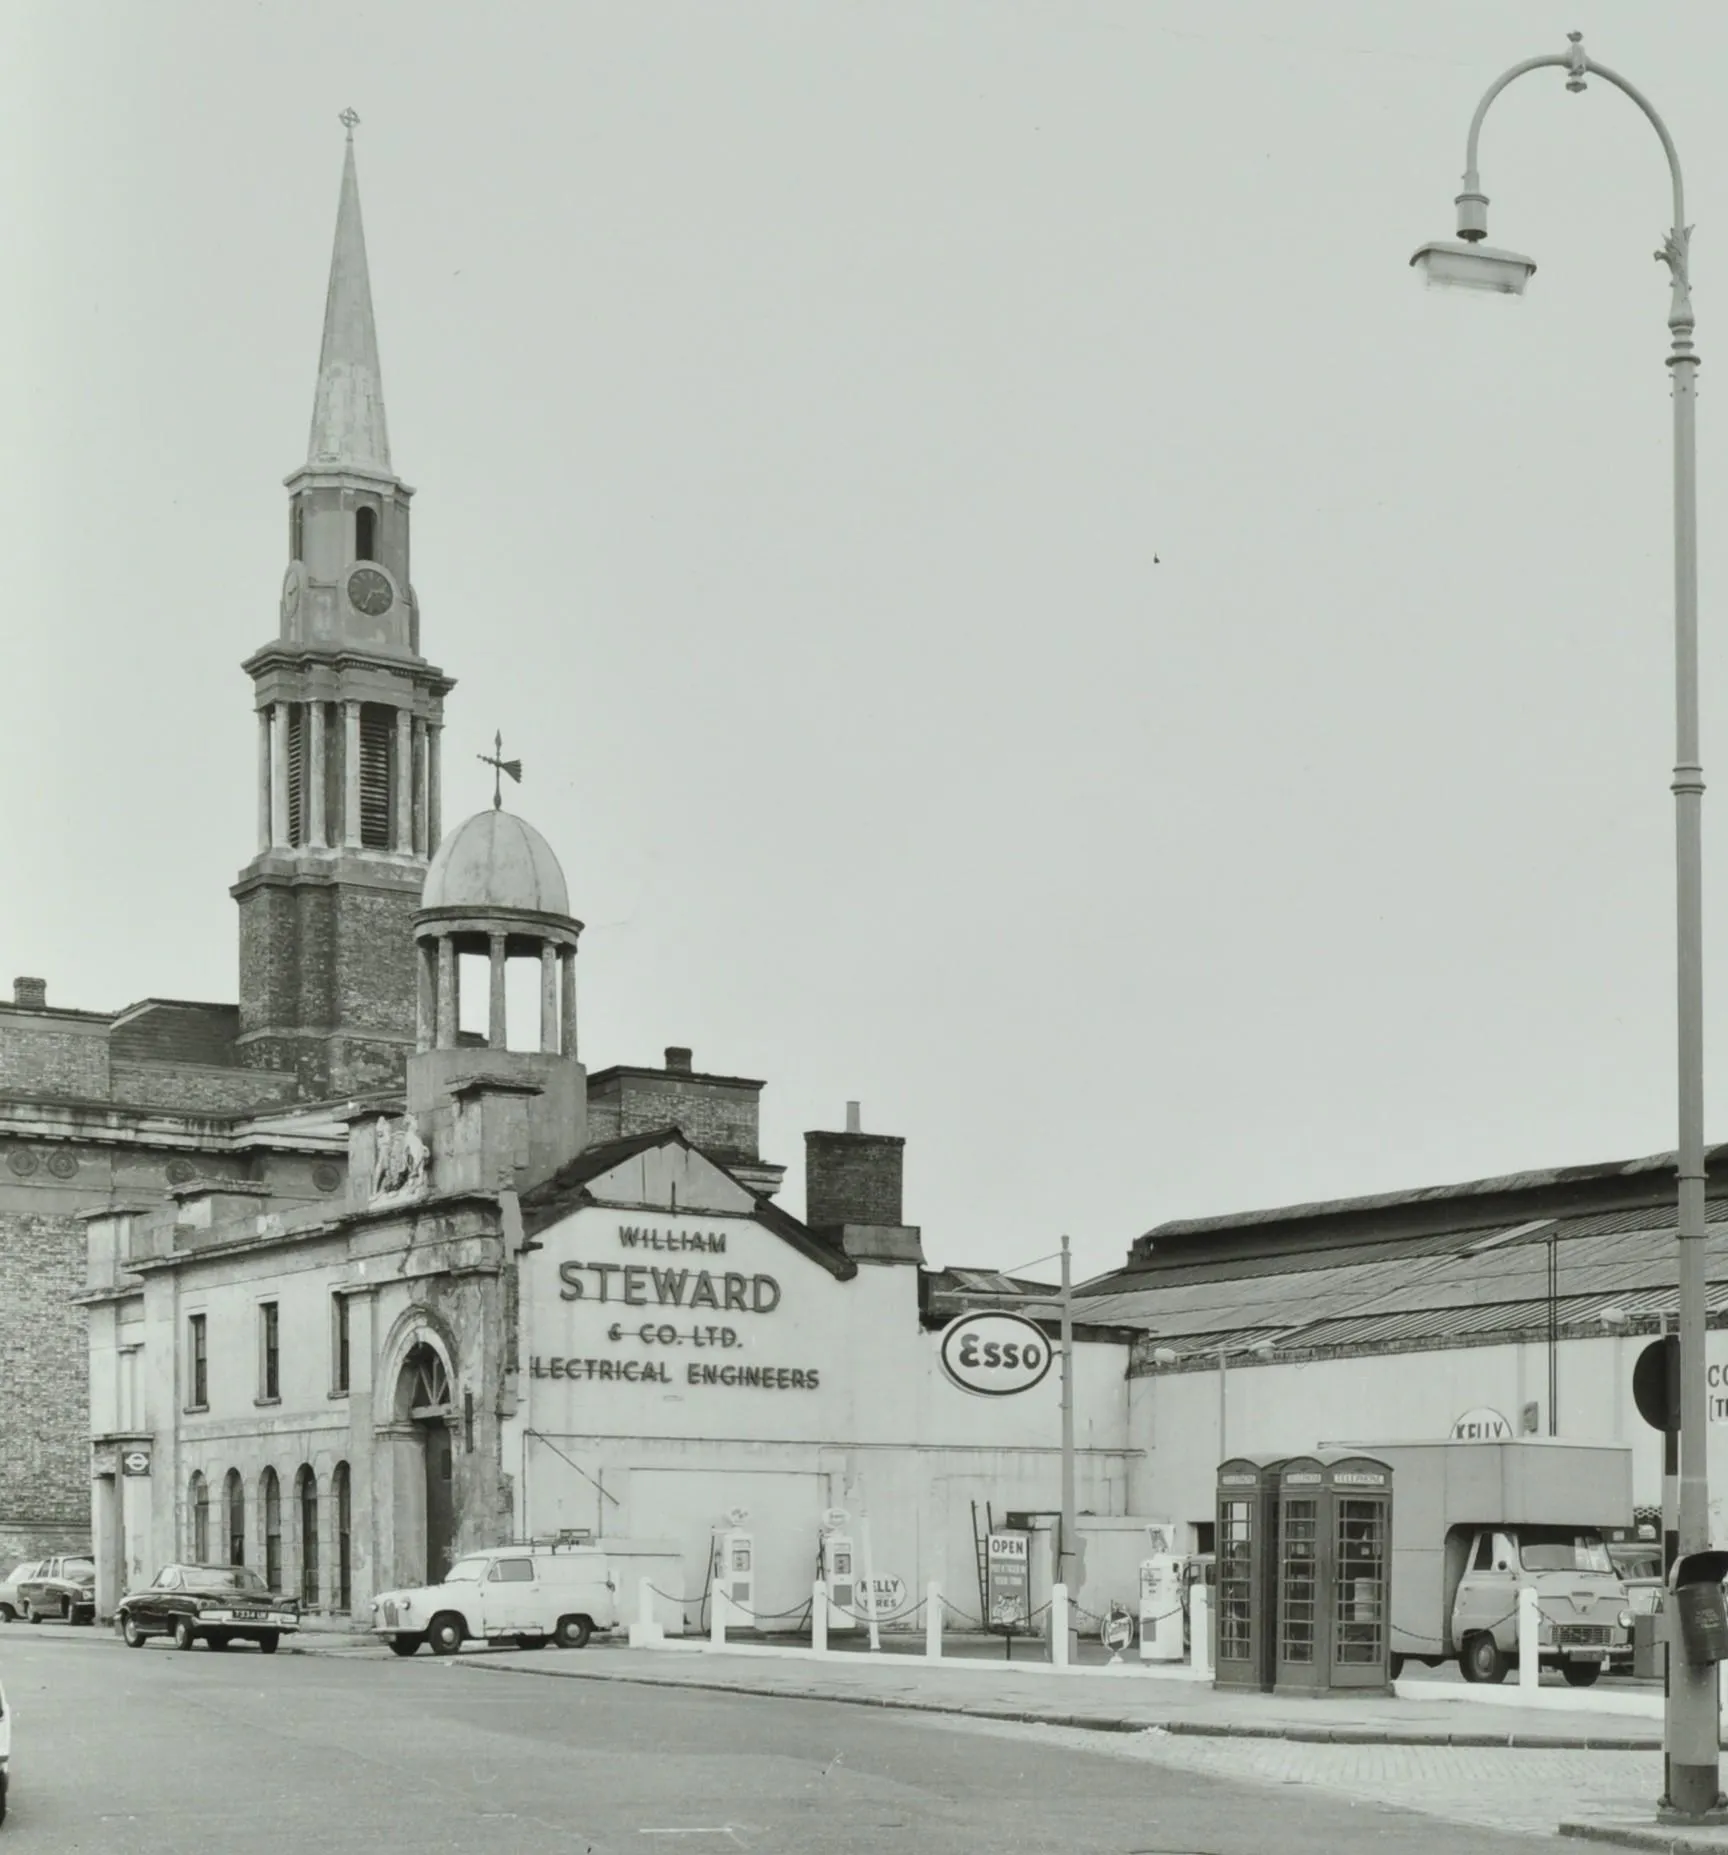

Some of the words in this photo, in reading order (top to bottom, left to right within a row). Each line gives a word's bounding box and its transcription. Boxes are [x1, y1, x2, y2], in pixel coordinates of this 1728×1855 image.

[619, 1226, 727, 1253] WILLIAM
[560, 1261, 781, 1313] STEWARD
[607, 1323, 622, 1341] &
[639, 1324, 683, 1346] CO.
[693, 1325, 743, 1348] LTD.
[687, 1362, 820, 1390] ENGINEERS
[992, 1539, 1024, 1555] OPEN
